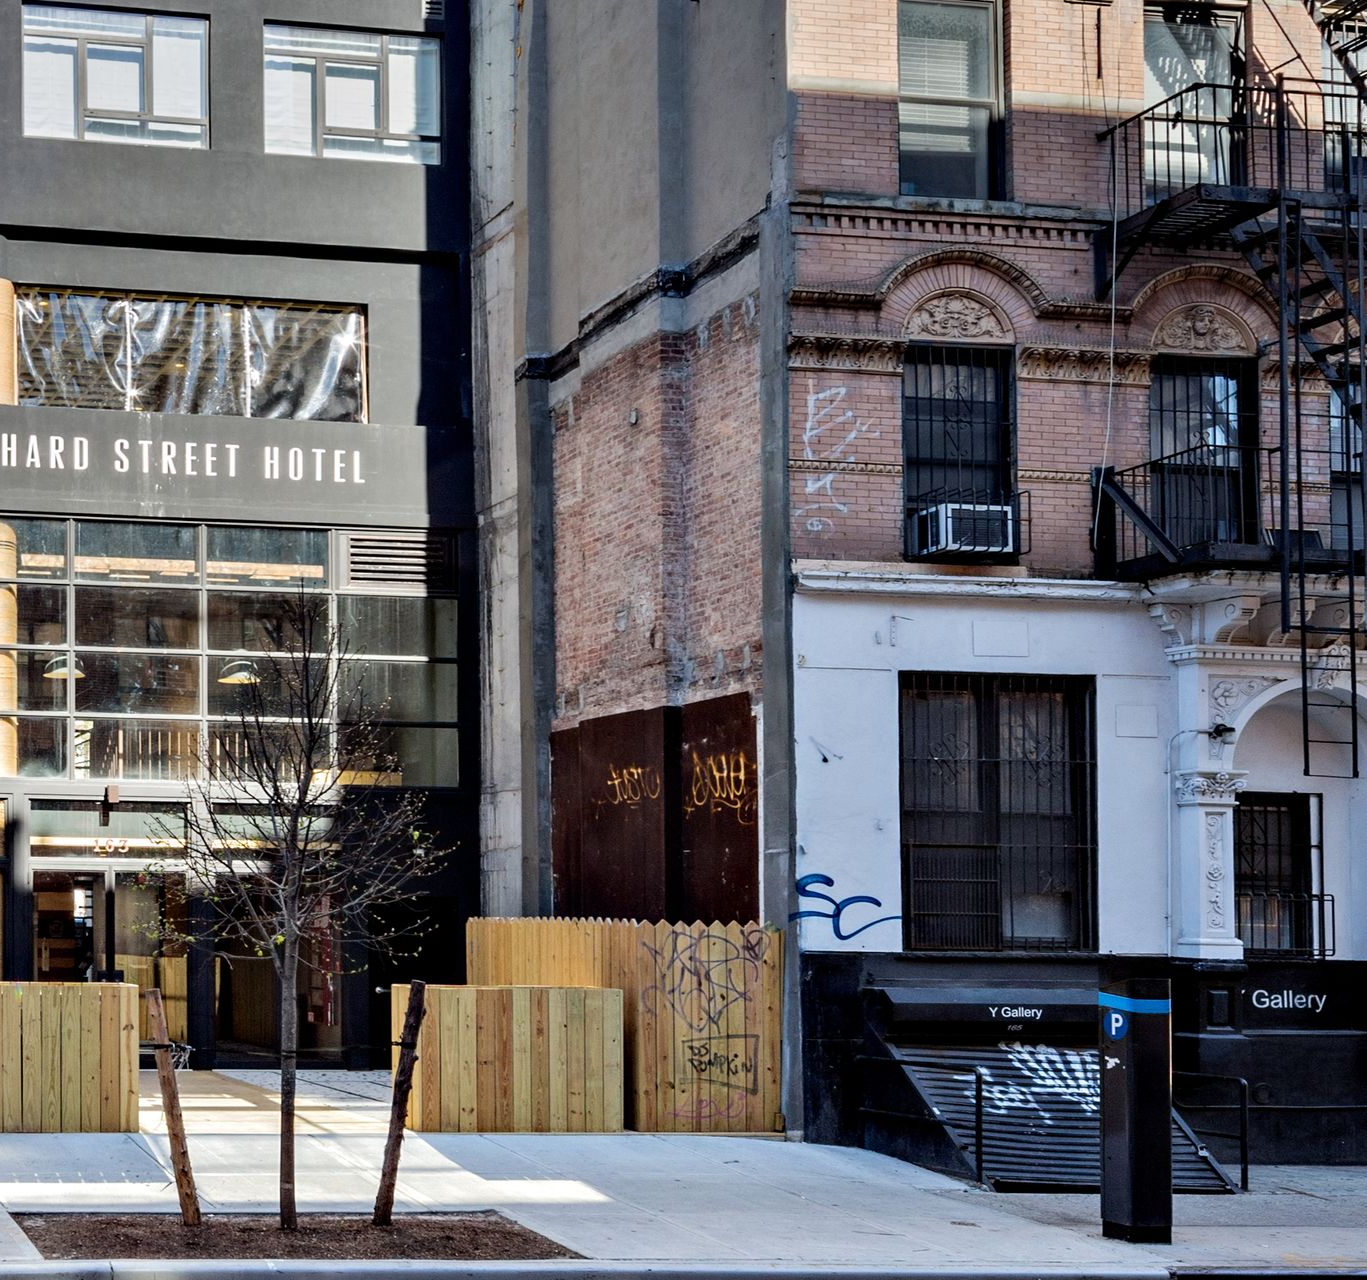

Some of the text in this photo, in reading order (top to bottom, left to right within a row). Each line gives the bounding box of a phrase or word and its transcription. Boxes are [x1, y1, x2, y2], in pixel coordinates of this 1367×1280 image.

[114, 438, 240, 478] STREET
[264, 446, 366, 484] HOTEL
[93, 839, 130, 853] 163
[1251, 989, 1327, 1013] Gallery
[988, 1006, 1043, 1020] Y Gallery
